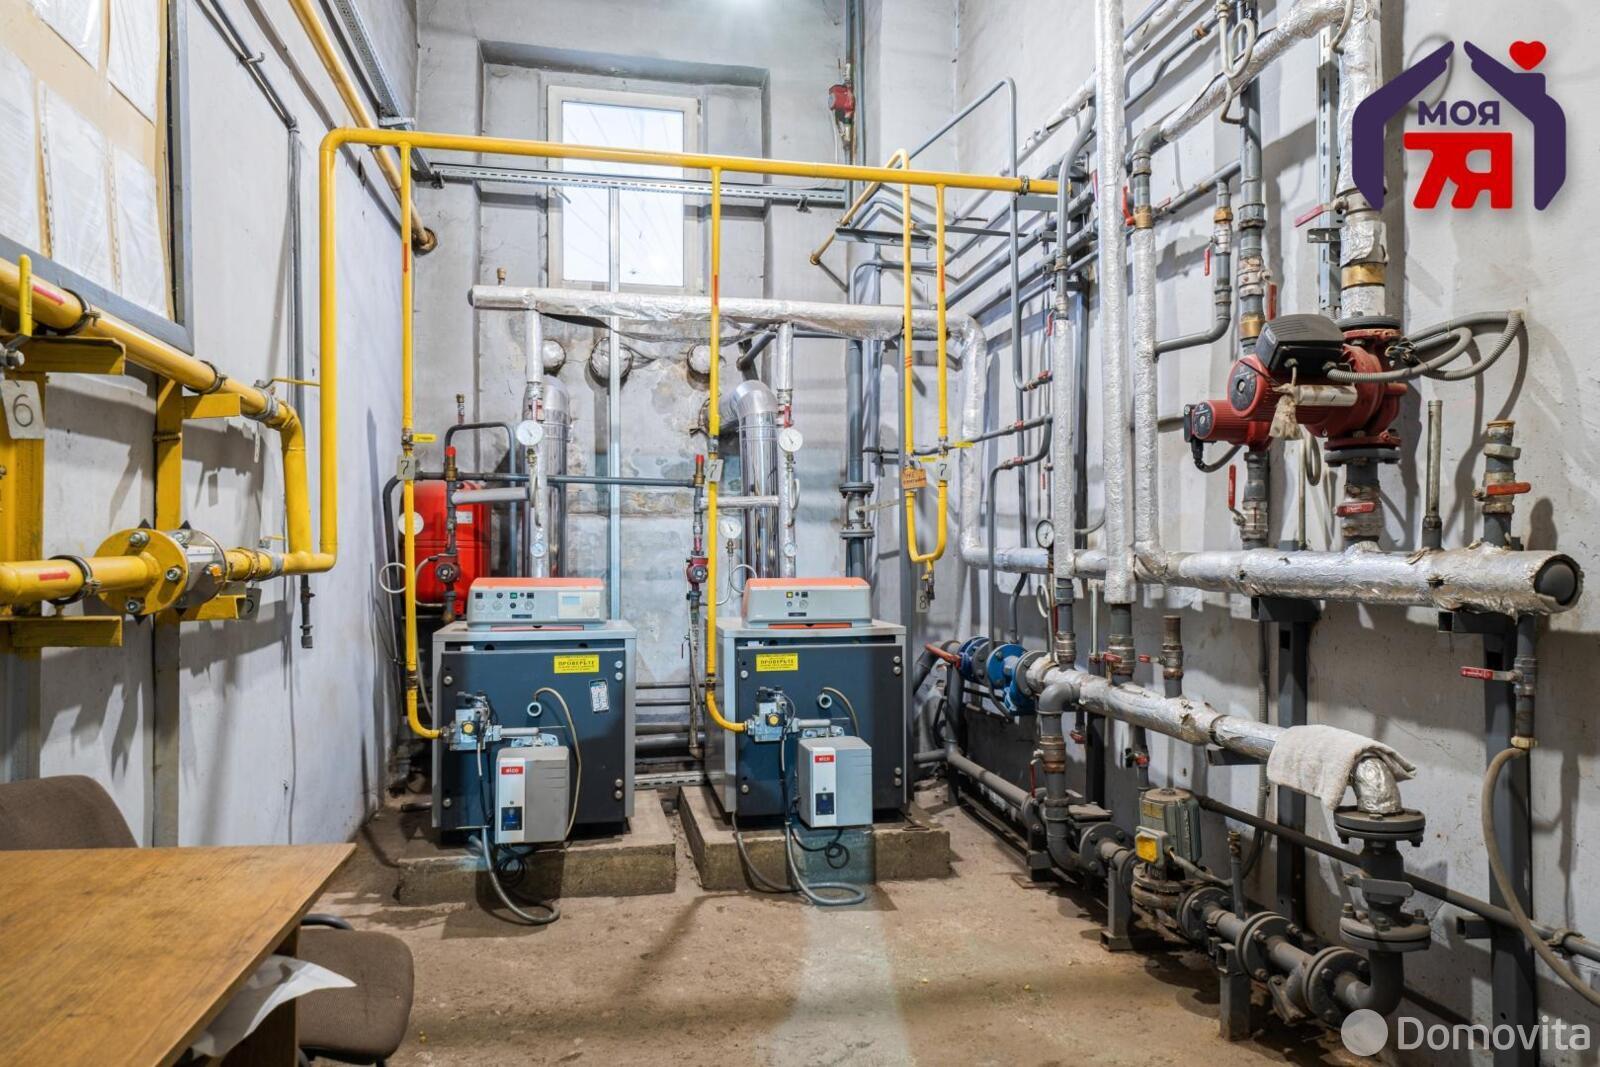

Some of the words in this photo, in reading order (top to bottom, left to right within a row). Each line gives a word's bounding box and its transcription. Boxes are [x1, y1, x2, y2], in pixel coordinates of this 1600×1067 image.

[12, 393, 34, 428] 6
[400, 459, 410, 476] 7
[710, 463, 718, 479] 7
[939, 463, 948, 476] 7
[920, 595, 927, 610] 8
